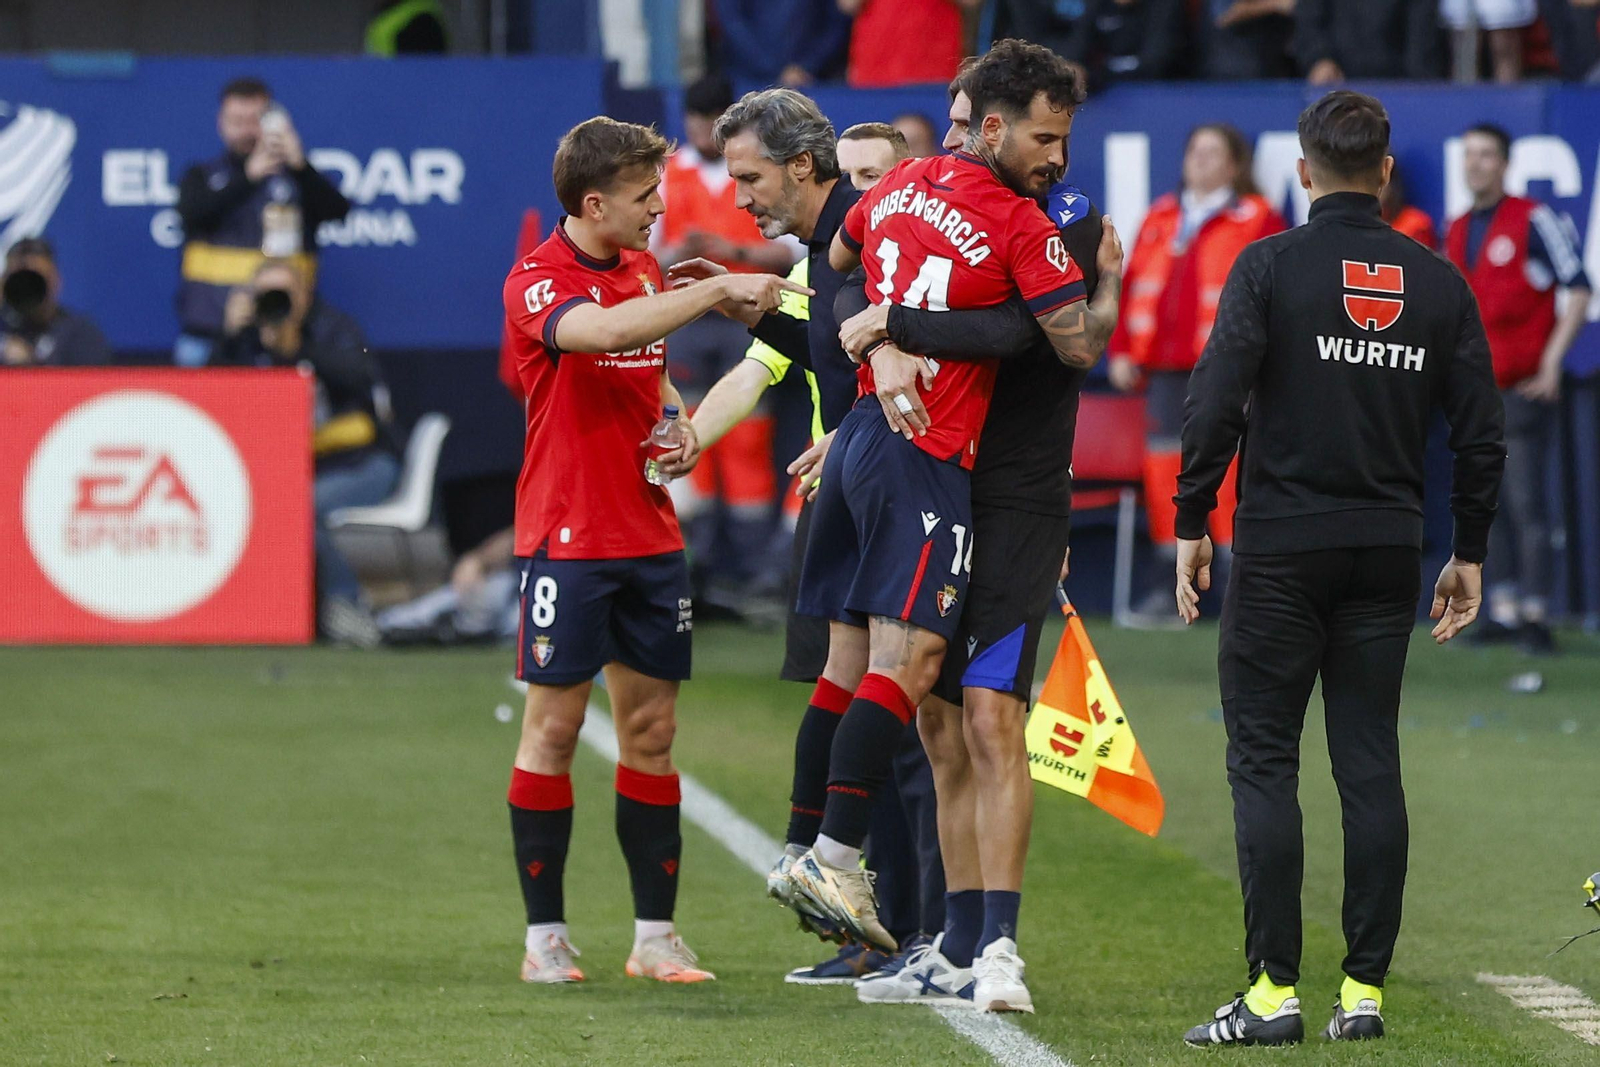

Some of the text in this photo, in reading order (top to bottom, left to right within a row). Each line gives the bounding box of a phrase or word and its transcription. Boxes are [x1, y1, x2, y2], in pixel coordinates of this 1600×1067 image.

[101, 148, 180, 205] EL
[875, 237, 953, 311] 14
[1316, 335, 1426, 371] WÜRTH
[76, 447, 201, 513] EA
[532, 576, 557, 628] 8
[1028, 752, 1086, 781] WÜRTH
